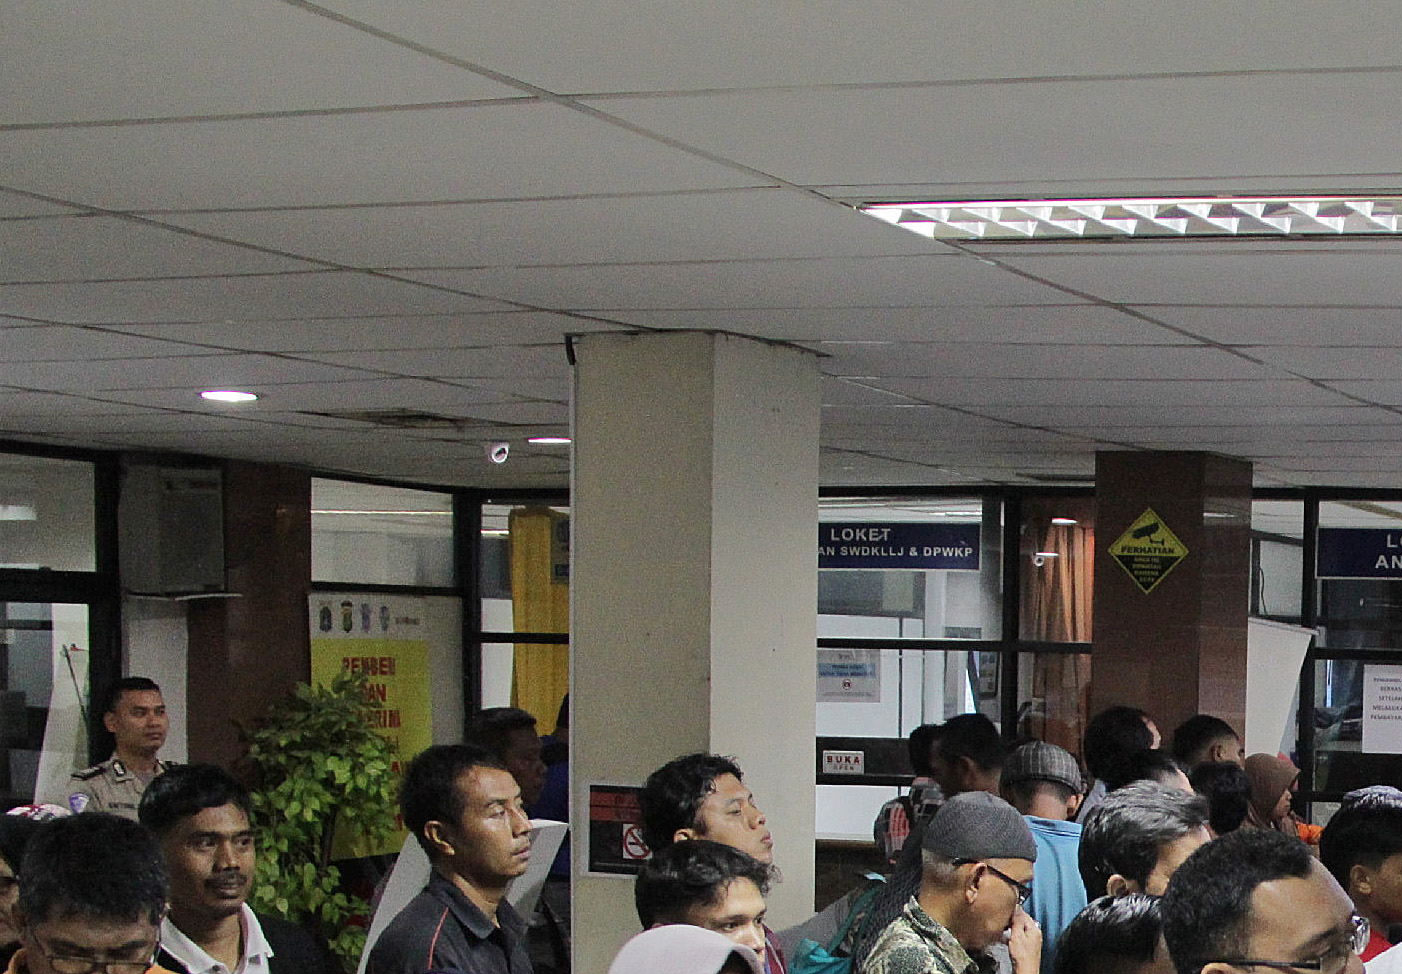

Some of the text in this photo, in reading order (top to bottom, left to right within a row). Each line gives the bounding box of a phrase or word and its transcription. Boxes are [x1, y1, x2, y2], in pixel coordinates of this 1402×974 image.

[831, 528, 892, 542] LOKET
[840, 547, 904, 556] SWDKLLJ
[909, 547, 918, 557] &
[923, 547, 973, 557] DPWKP
[827, 755, 860, 764] BUKA
